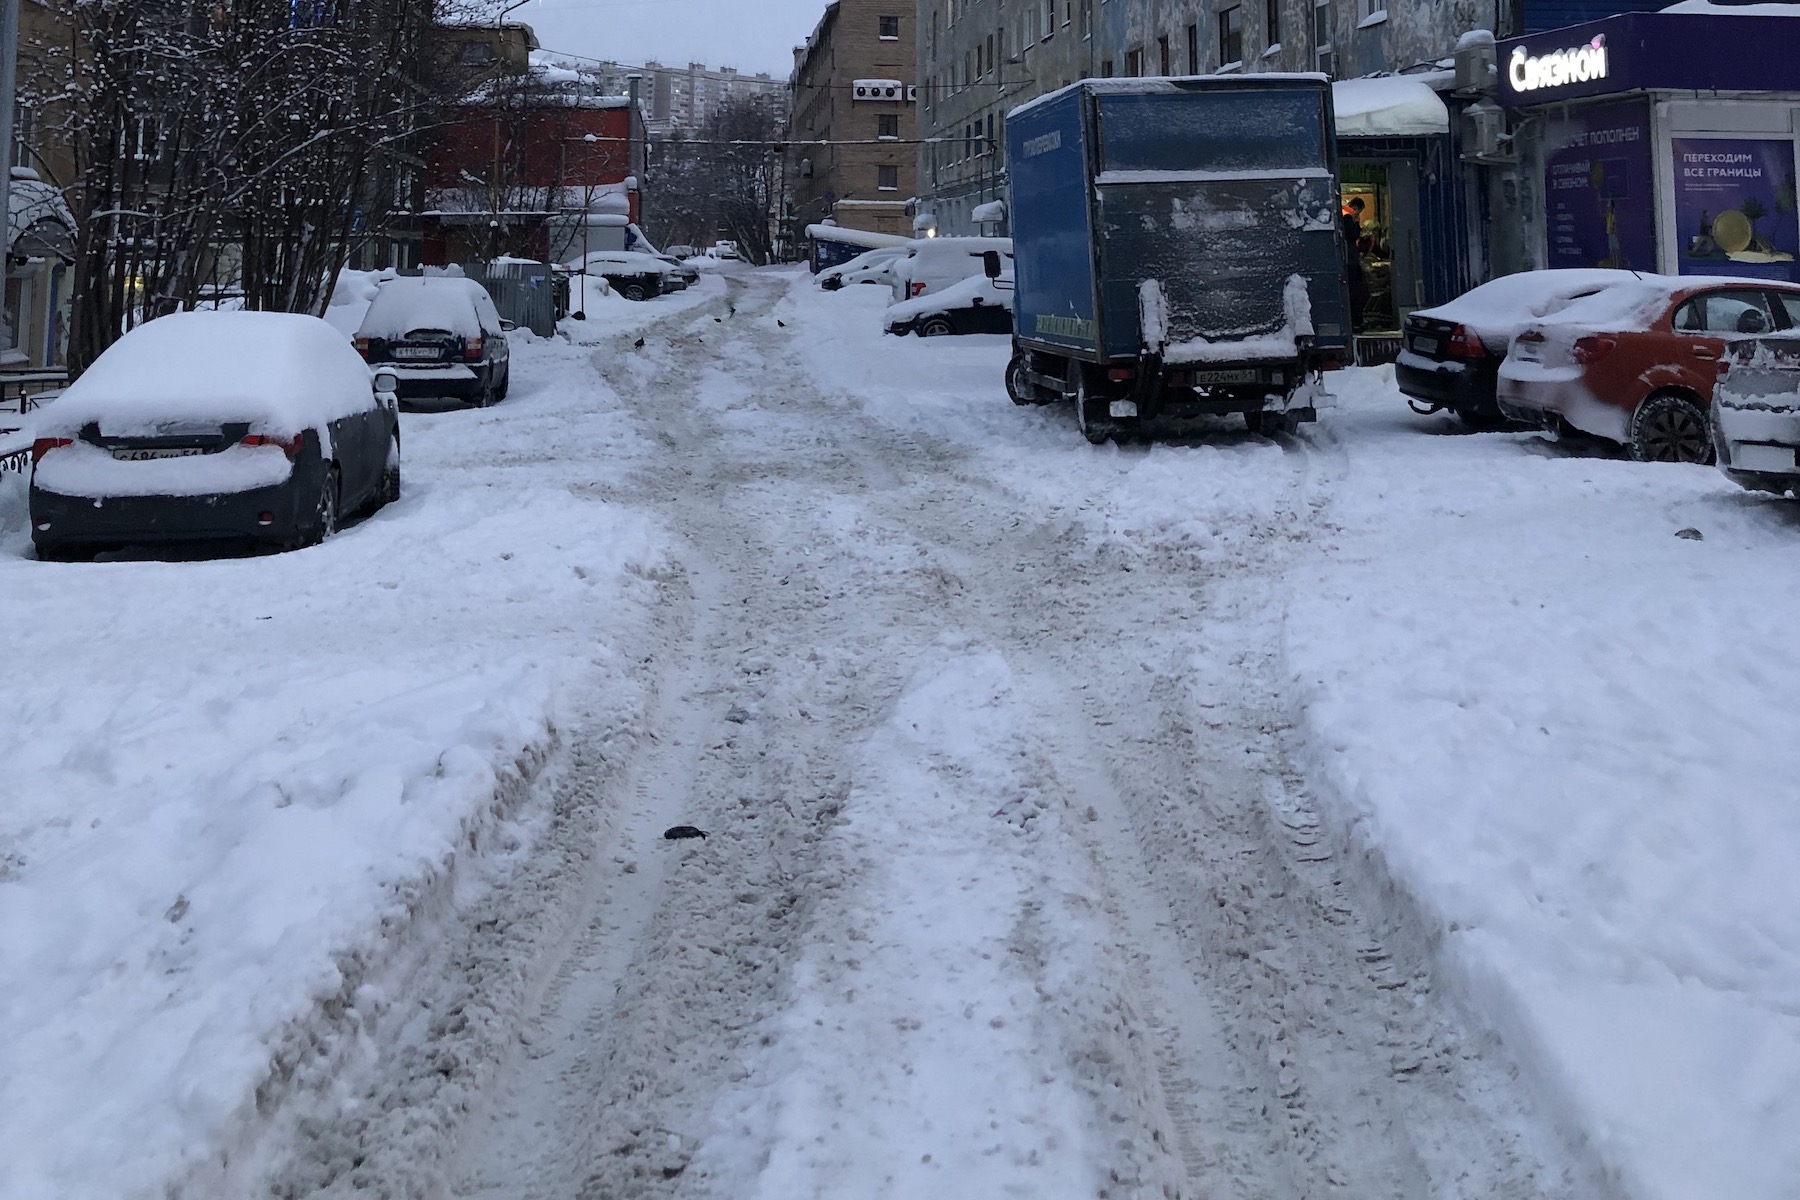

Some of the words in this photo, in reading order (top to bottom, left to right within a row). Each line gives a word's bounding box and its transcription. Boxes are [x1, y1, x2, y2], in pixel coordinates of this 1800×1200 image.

[1590, 126, 1640, 145] ПОПОЛНЕН
[1683, 153, 1752, 163] ПЕРЕХОДИМ
[1684, 168, 1704, 177] ВСЕ
[1707, 168, 1762, 178] ГРАНИЦЫ
